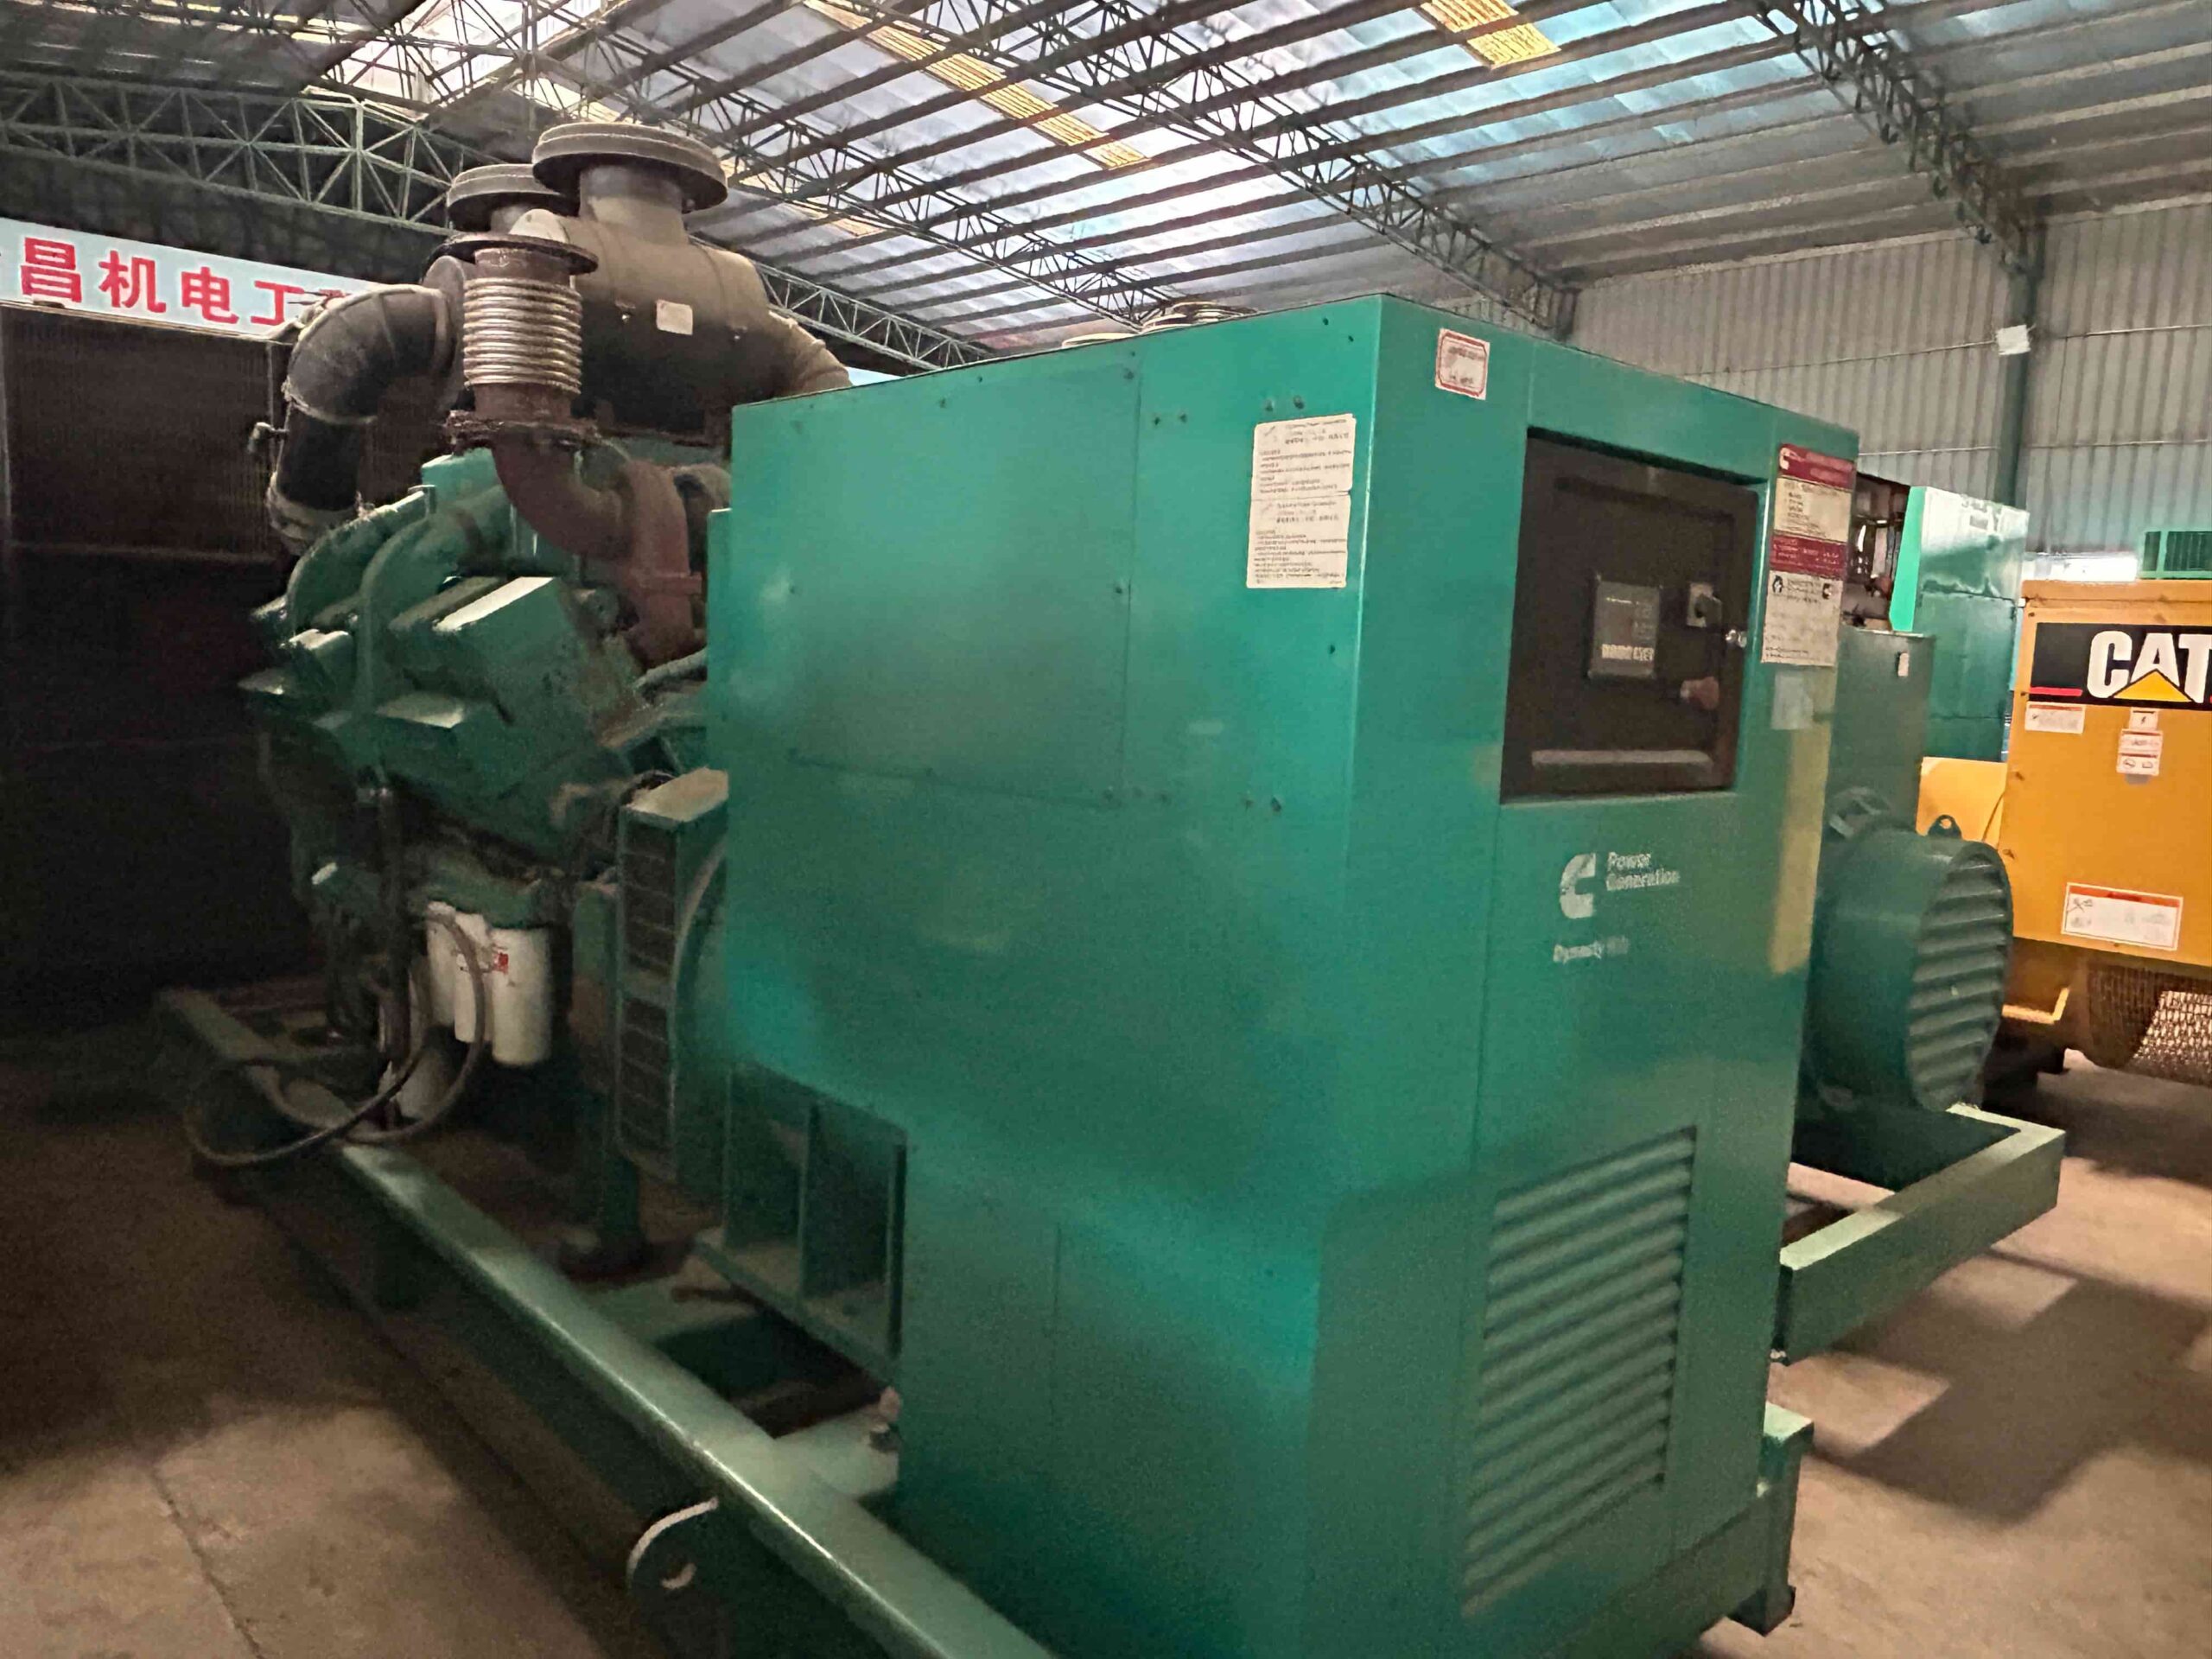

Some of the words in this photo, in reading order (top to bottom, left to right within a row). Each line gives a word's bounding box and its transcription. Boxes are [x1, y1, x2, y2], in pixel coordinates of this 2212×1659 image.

[21, 237, 344, 327] 昌机电工
[2087, 631, 2212, 703] CAT
